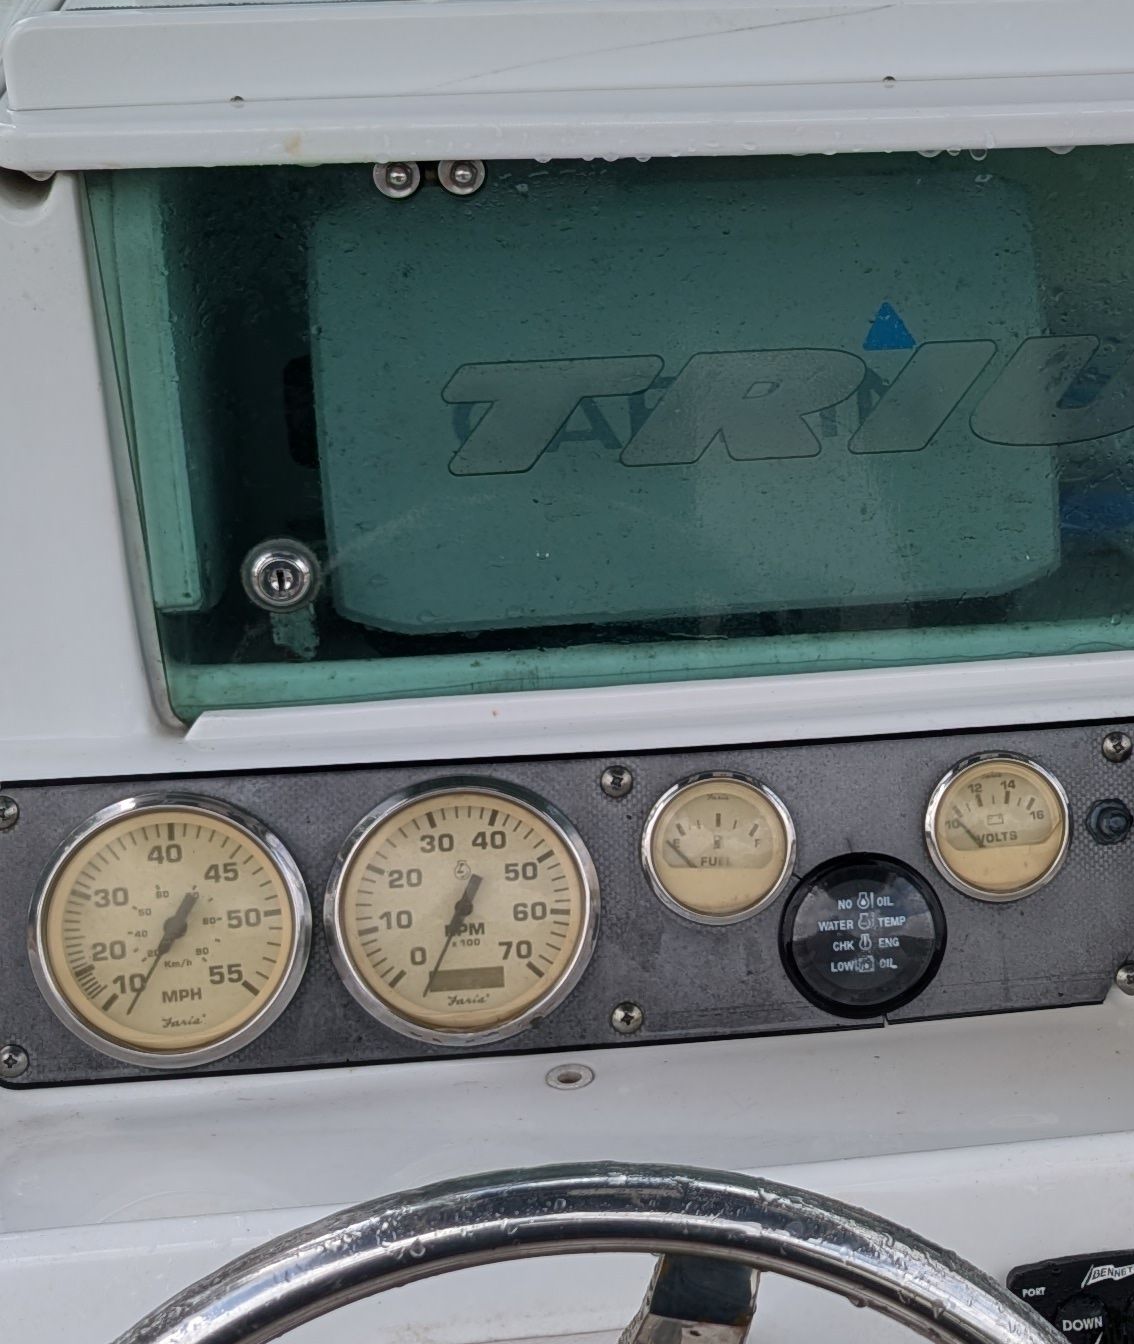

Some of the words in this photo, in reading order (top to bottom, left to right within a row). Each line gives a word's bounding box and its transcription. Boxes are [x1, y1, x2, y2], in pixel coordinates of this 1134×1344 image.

[968, 783, 983, 793] 12
[1000, 779, 1016, 790] 14
[945, 819, 961, 829] 10
[1030, 810, 1044, 820] 16
[420, 833, 454, 853] 30
[472, 831, 507, 850] 40
[754, 838, 761, 848] F
[977, 831, 1018, 843] VOLTS
[148, 843, 183, 864] 40
[204, 862, 239, 883] 45
[388, 868, 423, 889] 20
[505, 862, 538, 881] 50
[94, 887, 129, 908] 30
[837, 899, 853, 910] NO
[876, 896, 894, 907] OIL
[227, 908, 262, 929] 50
[379, 910, 413, 930] 10
[513, 902, 547, 921] 60
[818, 919, 854, 932] WATER
[877, 916, 906, 927] TEMP
[91, 940, 127, 961] 20
[498, 940, 532, 960] 70
[832, 940, 855, 952] CHK
[878, 937, 900, 948] ENG
[410, 947, 427, 966] 0
[830, 961, 856, 973] LOW
[879, 958, 898, 969] OIL
[112, 973, 146, 994] 10
[209, 964, 243, 985] 55
[162, 988, 203, 1004] MPH
[1022, 1286, 1046, 1298] PORT
[1062, 1316, 1103, 1332] DOWN
